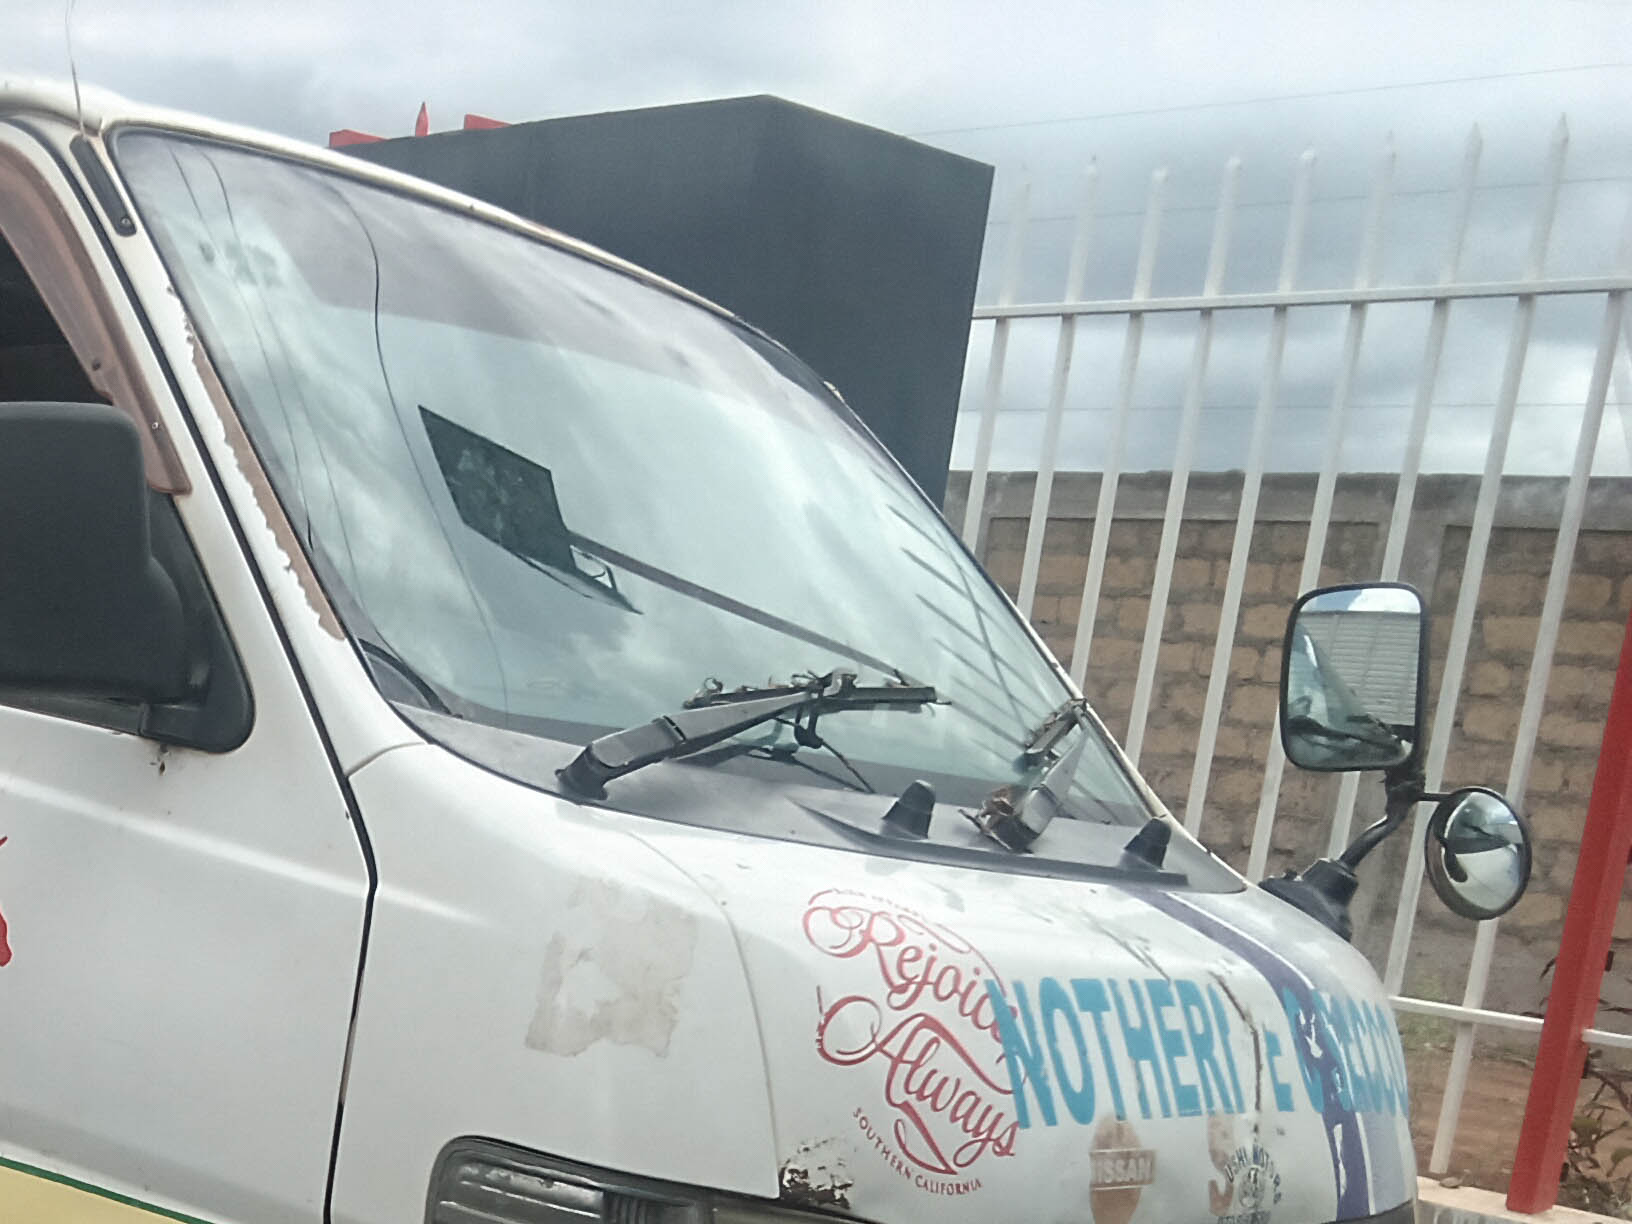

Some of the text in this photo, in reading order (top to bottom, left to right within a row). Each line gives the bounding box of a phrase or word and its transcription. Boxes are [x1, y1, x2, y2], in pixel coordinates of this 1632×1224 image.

[817, 1012, 1020, 1175] Always
[853, 1106, 983, 1196] SOUTHERN CALIFORNIA
